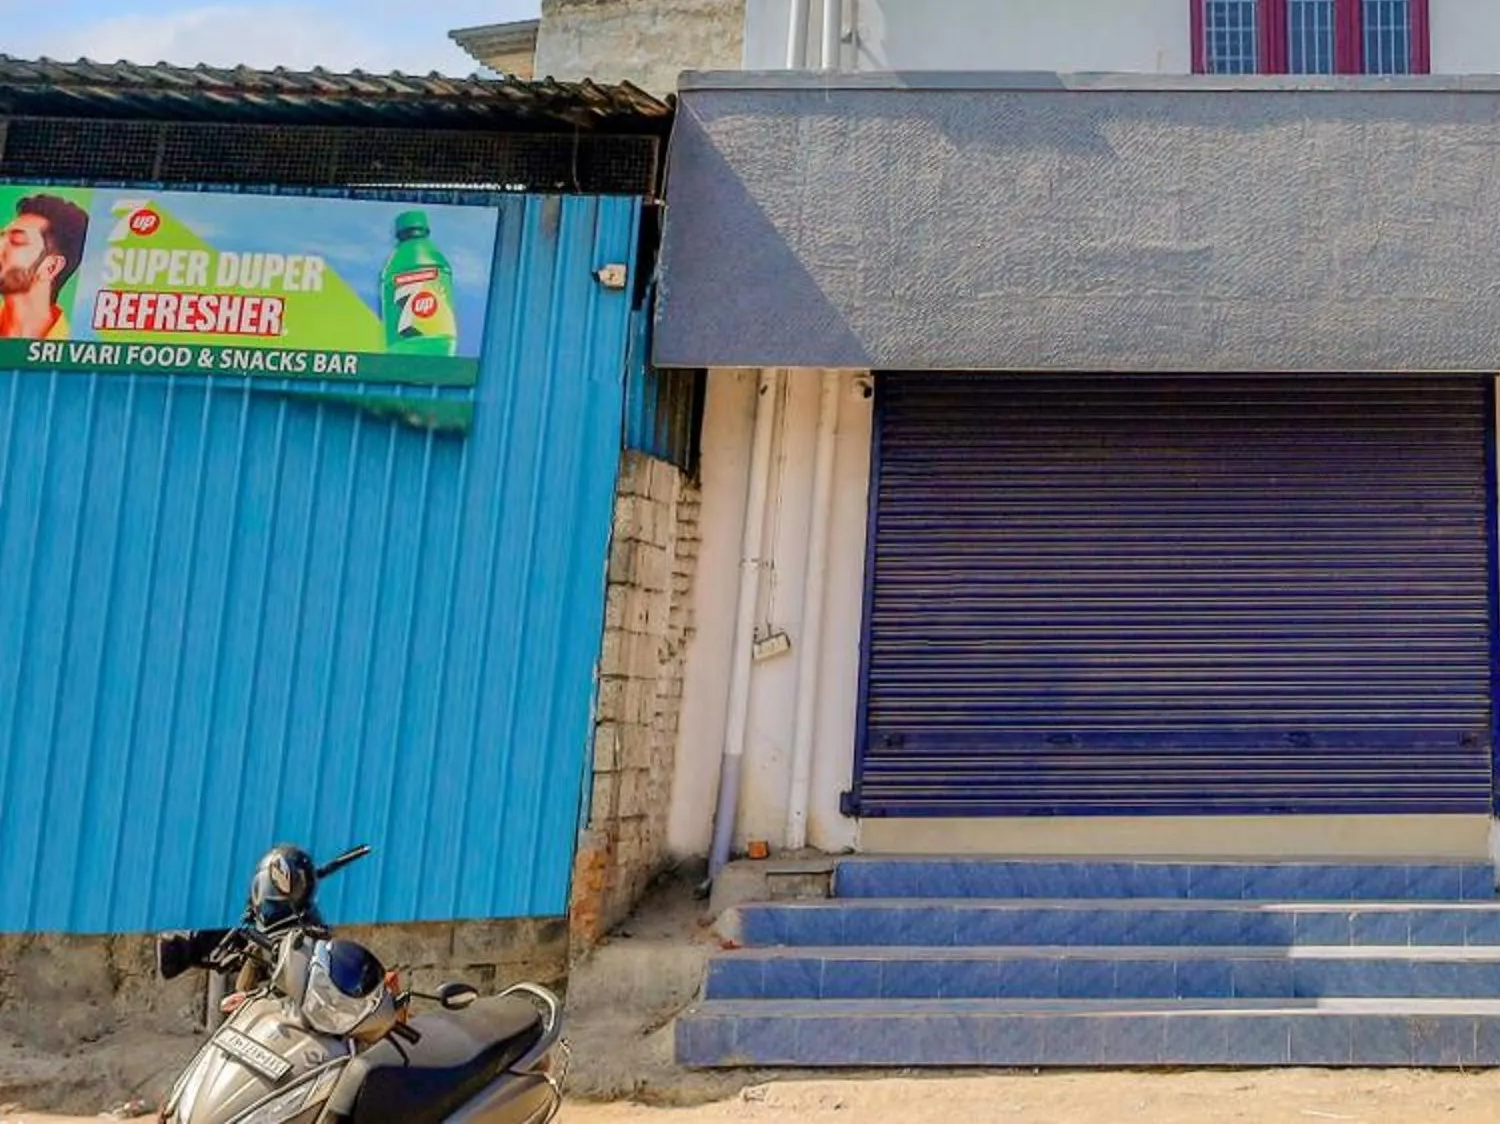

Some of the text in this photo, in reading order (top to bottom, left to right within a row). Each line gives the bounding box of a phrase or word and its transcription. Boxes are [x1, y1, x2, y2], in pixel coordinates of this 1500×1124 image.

[103, 247, 326, 292] SUPER DUPER
[27, 341, 358, 375] SRI VARI FOOD & SNACKS BAR
